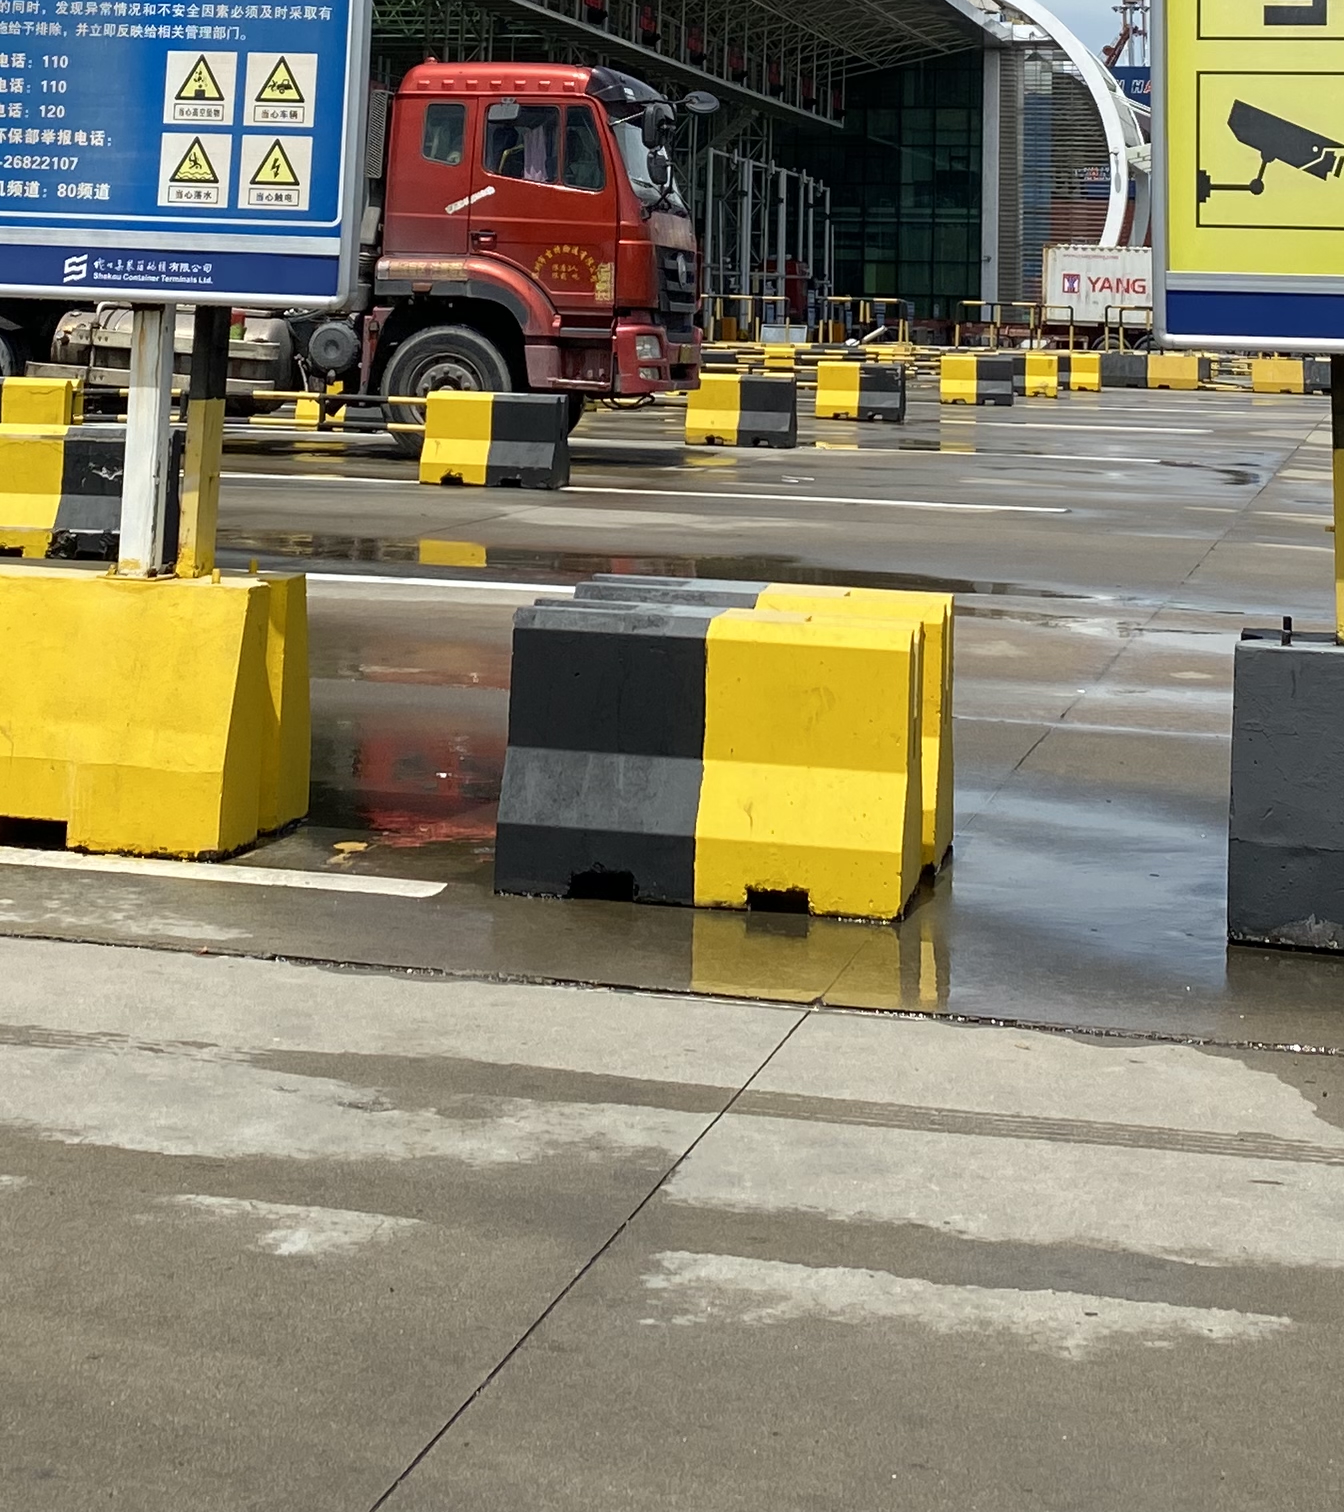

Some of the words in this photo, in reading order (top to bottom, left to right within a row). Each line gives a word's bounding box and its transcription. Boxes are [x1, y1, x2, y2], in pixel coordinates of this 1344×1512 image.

[261, 109, 298, 119] 当心车辆
[175, 189, 212, 199] 当心落水
[256, 192, 293, 202] 当心触电
[93, 272, 121, 280] Shekou
[123, 274, 159, 282] Container
[161, 275, 197, 283] Terminals
[1087, 277, 1146, 294] YANG
